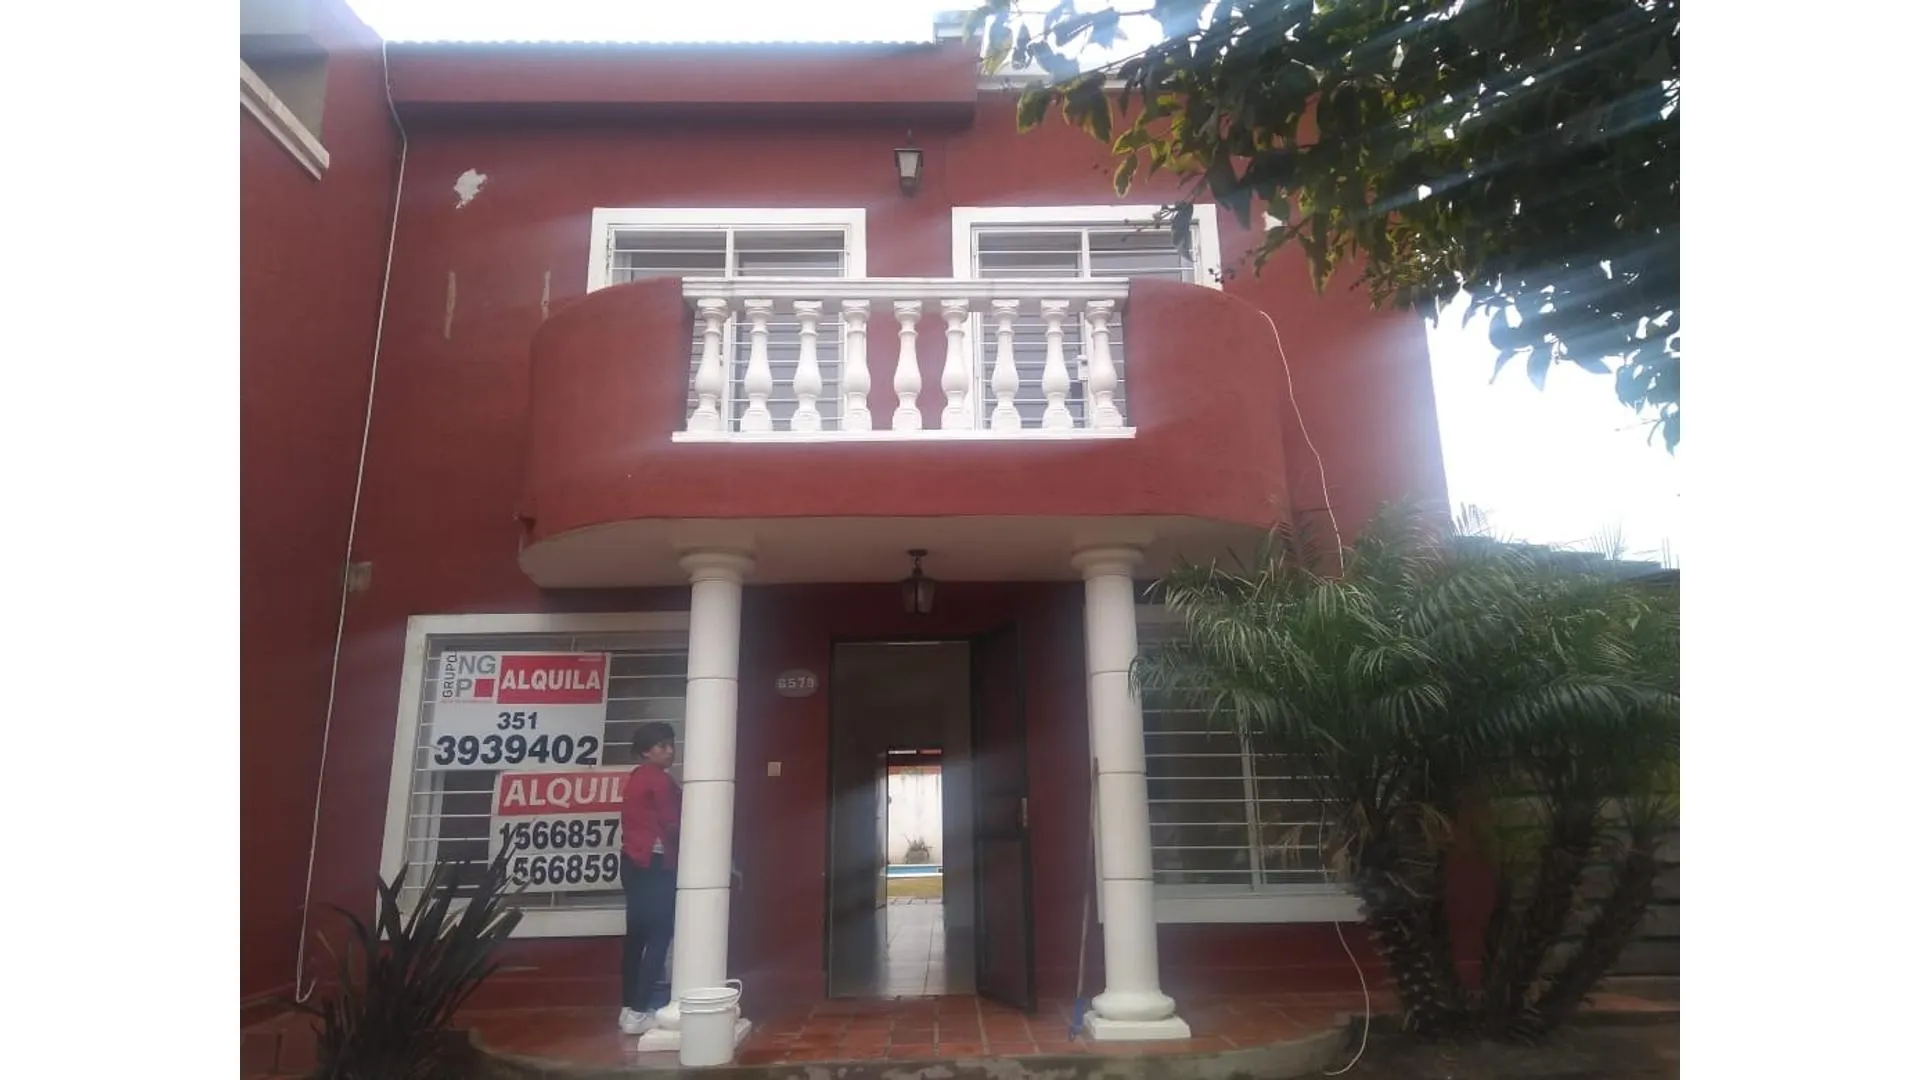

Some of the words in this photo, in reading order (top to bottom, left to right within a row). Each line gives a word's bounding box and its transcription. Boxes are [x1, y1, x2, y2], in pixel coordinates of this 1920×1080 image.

[442, 653, 457, 698] GRUPO
[458, 655, 496, 675] NG
[500, 669, 601, 691] ALQUILA
[497, 711, 538, 730] 351
[434, 734, 599, 766] 3939402
[503, 776, 624, 809] ALQUIL
[500, 819, 622, 850] 1566857
[502, 853, 620, 886] 566859
